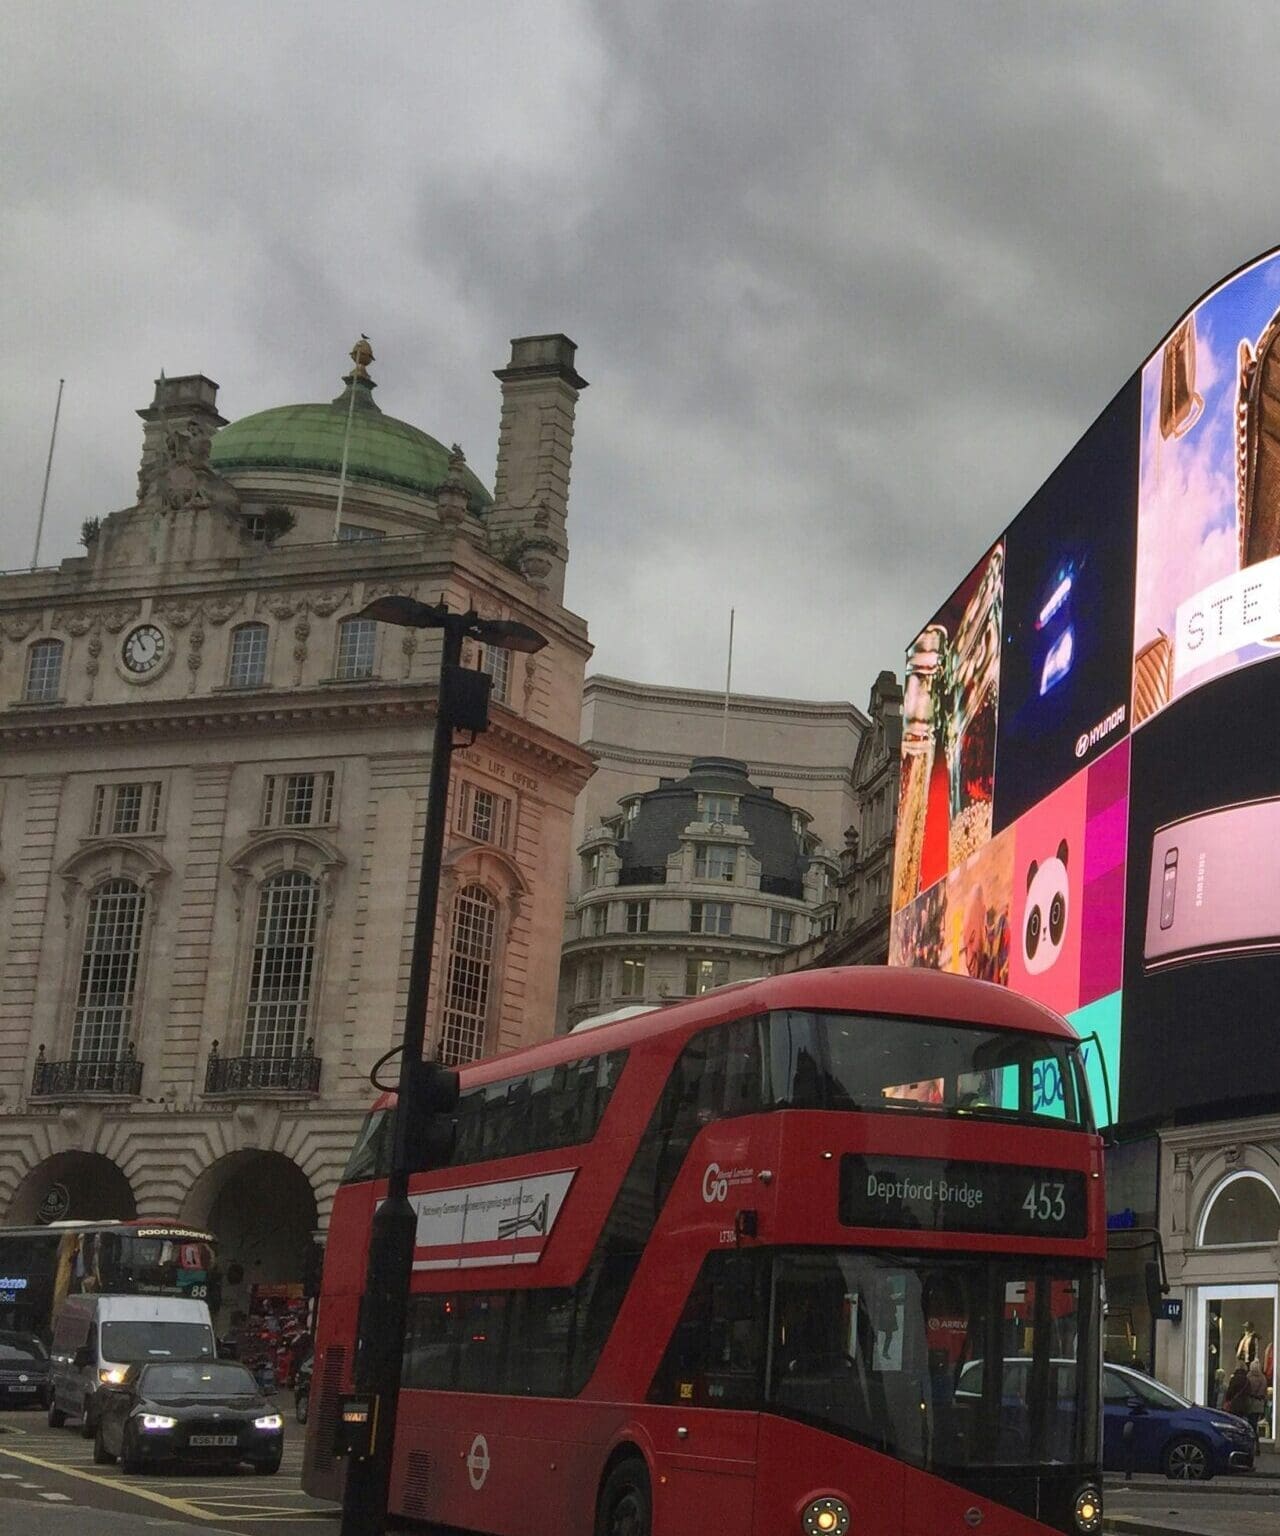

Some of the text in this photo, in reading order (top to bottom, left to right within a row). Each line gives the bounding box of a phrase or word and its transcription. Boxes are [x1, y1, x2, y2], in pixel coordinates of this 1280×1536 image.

[1089, 704, 1126, 746] HYUNDAI
[488, 760, 506, 777] LIFE
[512, 772, 539, 792] OFFICE
[702, 1162, 728, 1203] Go
[1021, 1180, 1067, 1221] 453
[137, 1228, 214, 1240] paco rabanne
[191, 1285, 207, 1298] 88
